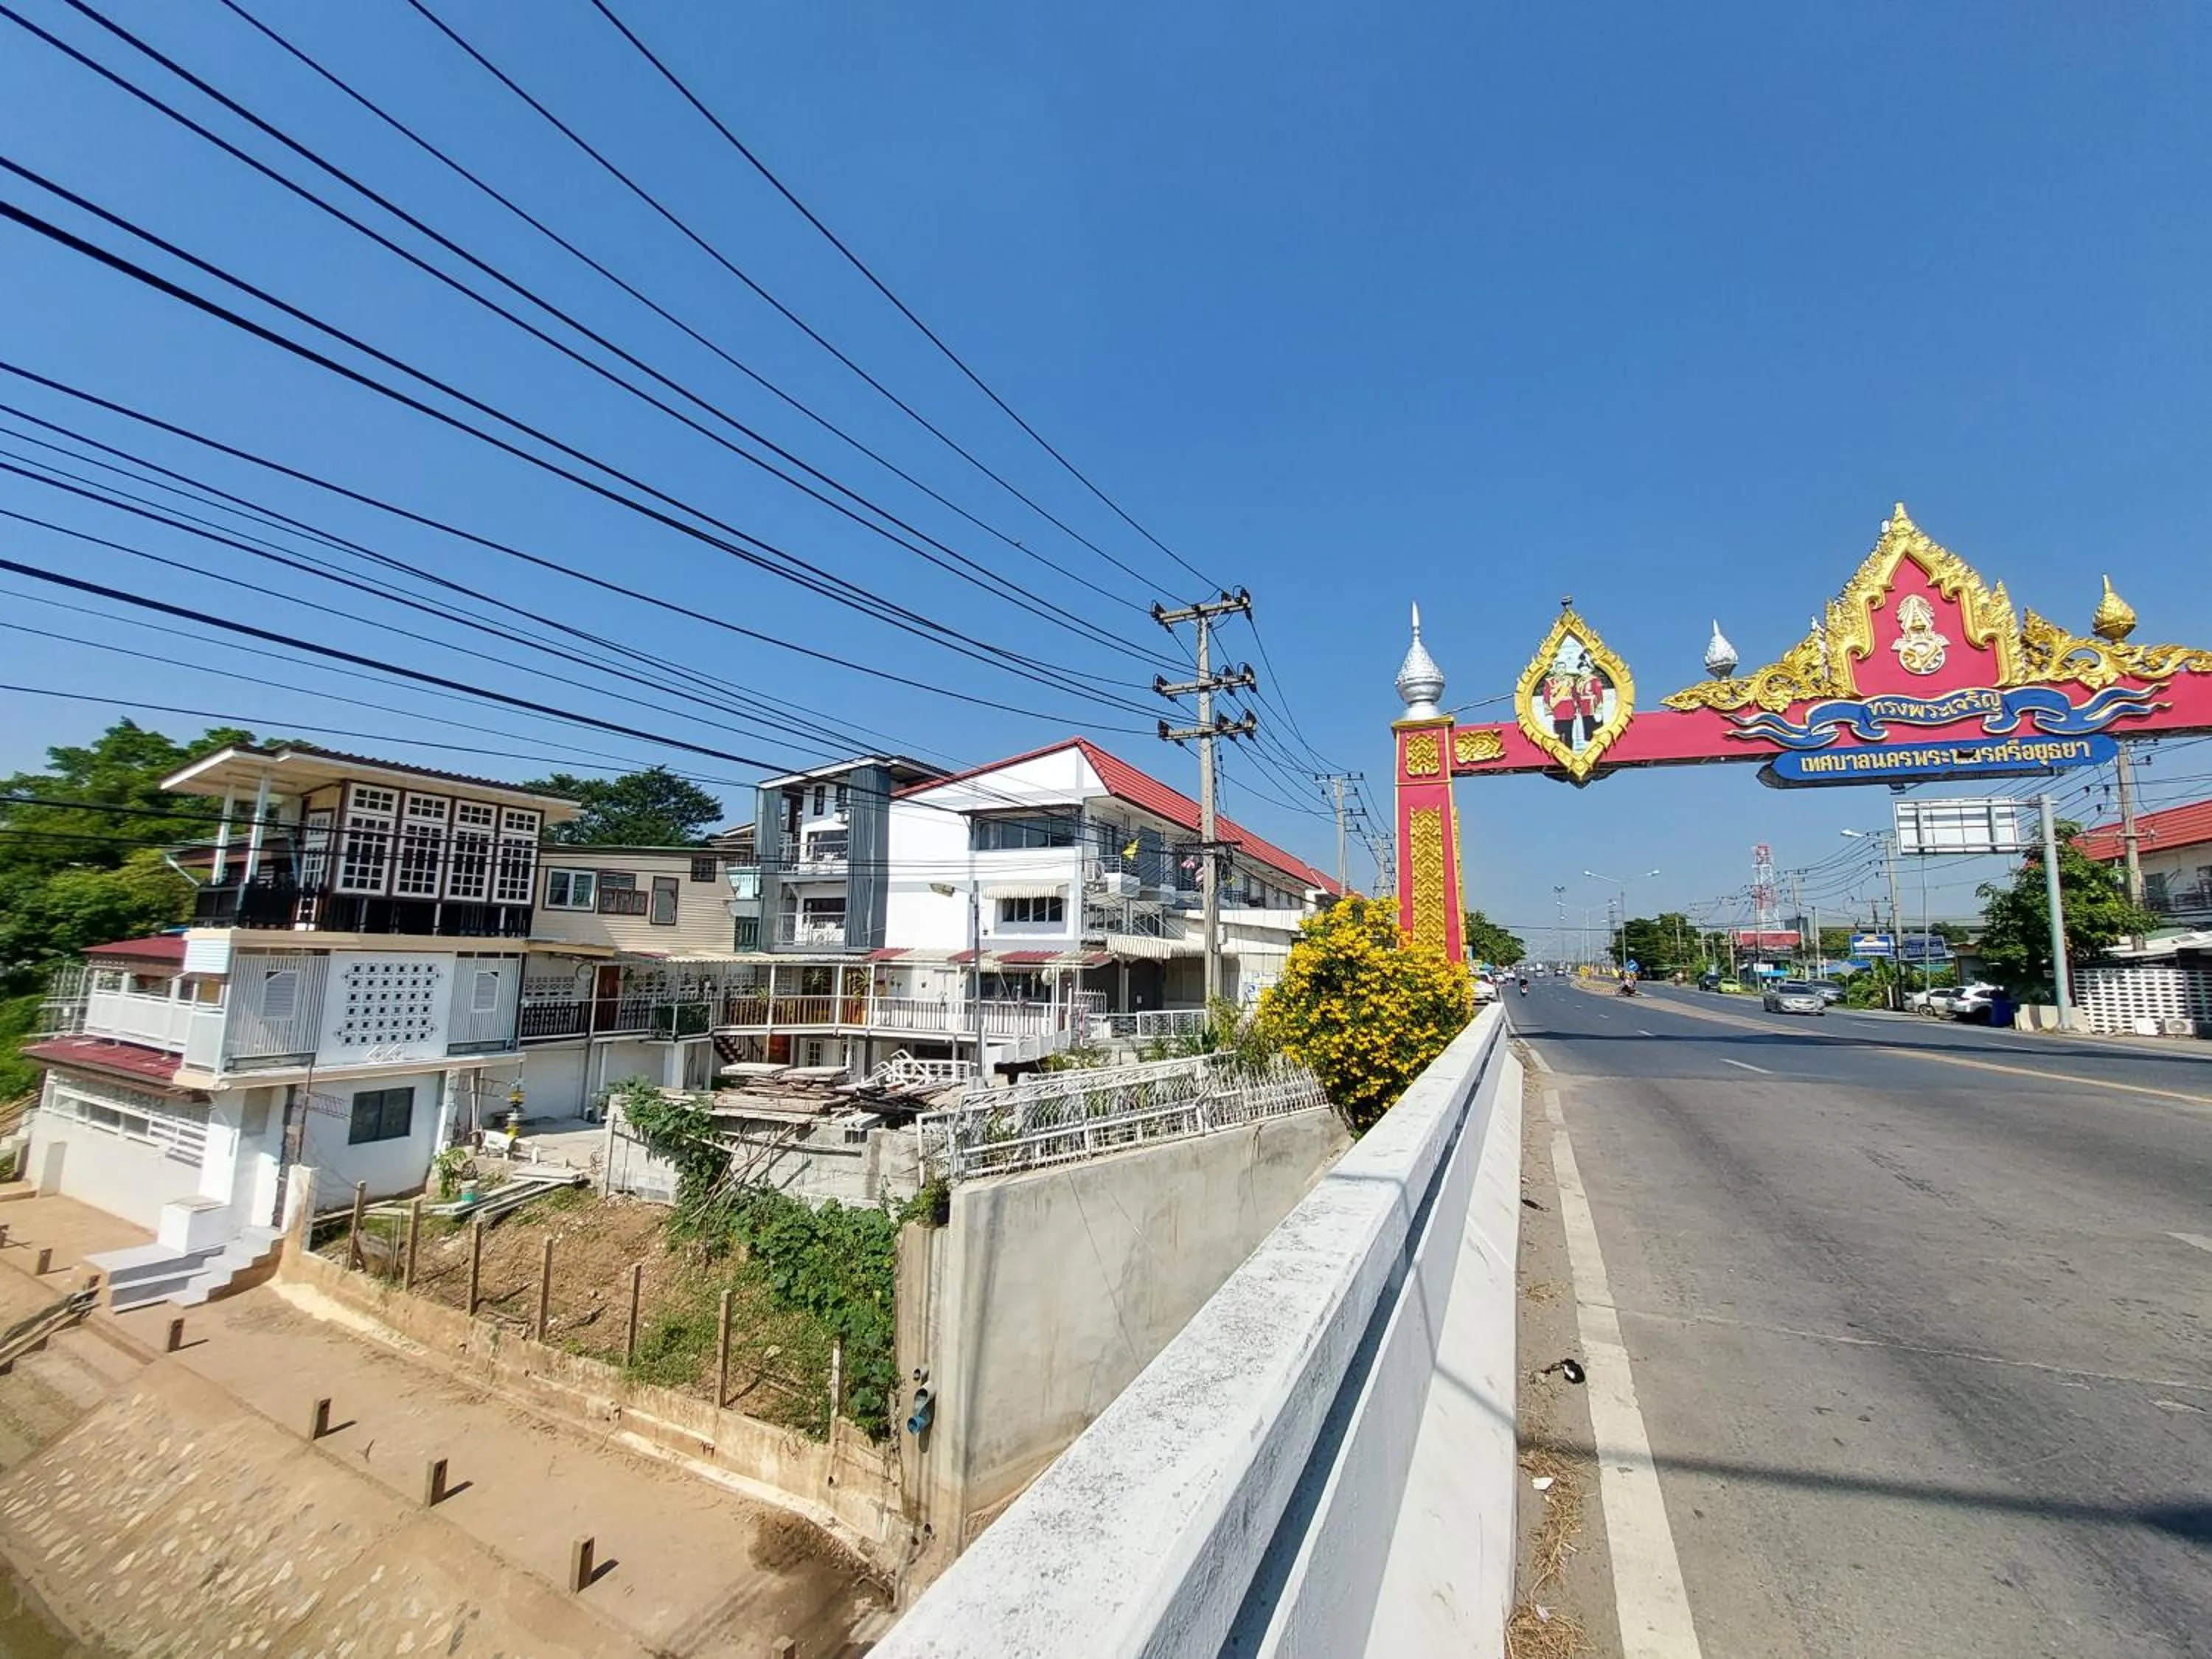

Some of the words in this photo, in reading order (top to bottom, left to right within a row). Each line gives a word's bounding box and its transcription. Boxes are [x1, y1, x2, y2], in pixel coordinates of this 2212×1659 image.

[1865, 690, 2002, 719] ทรงพระเจริญ
